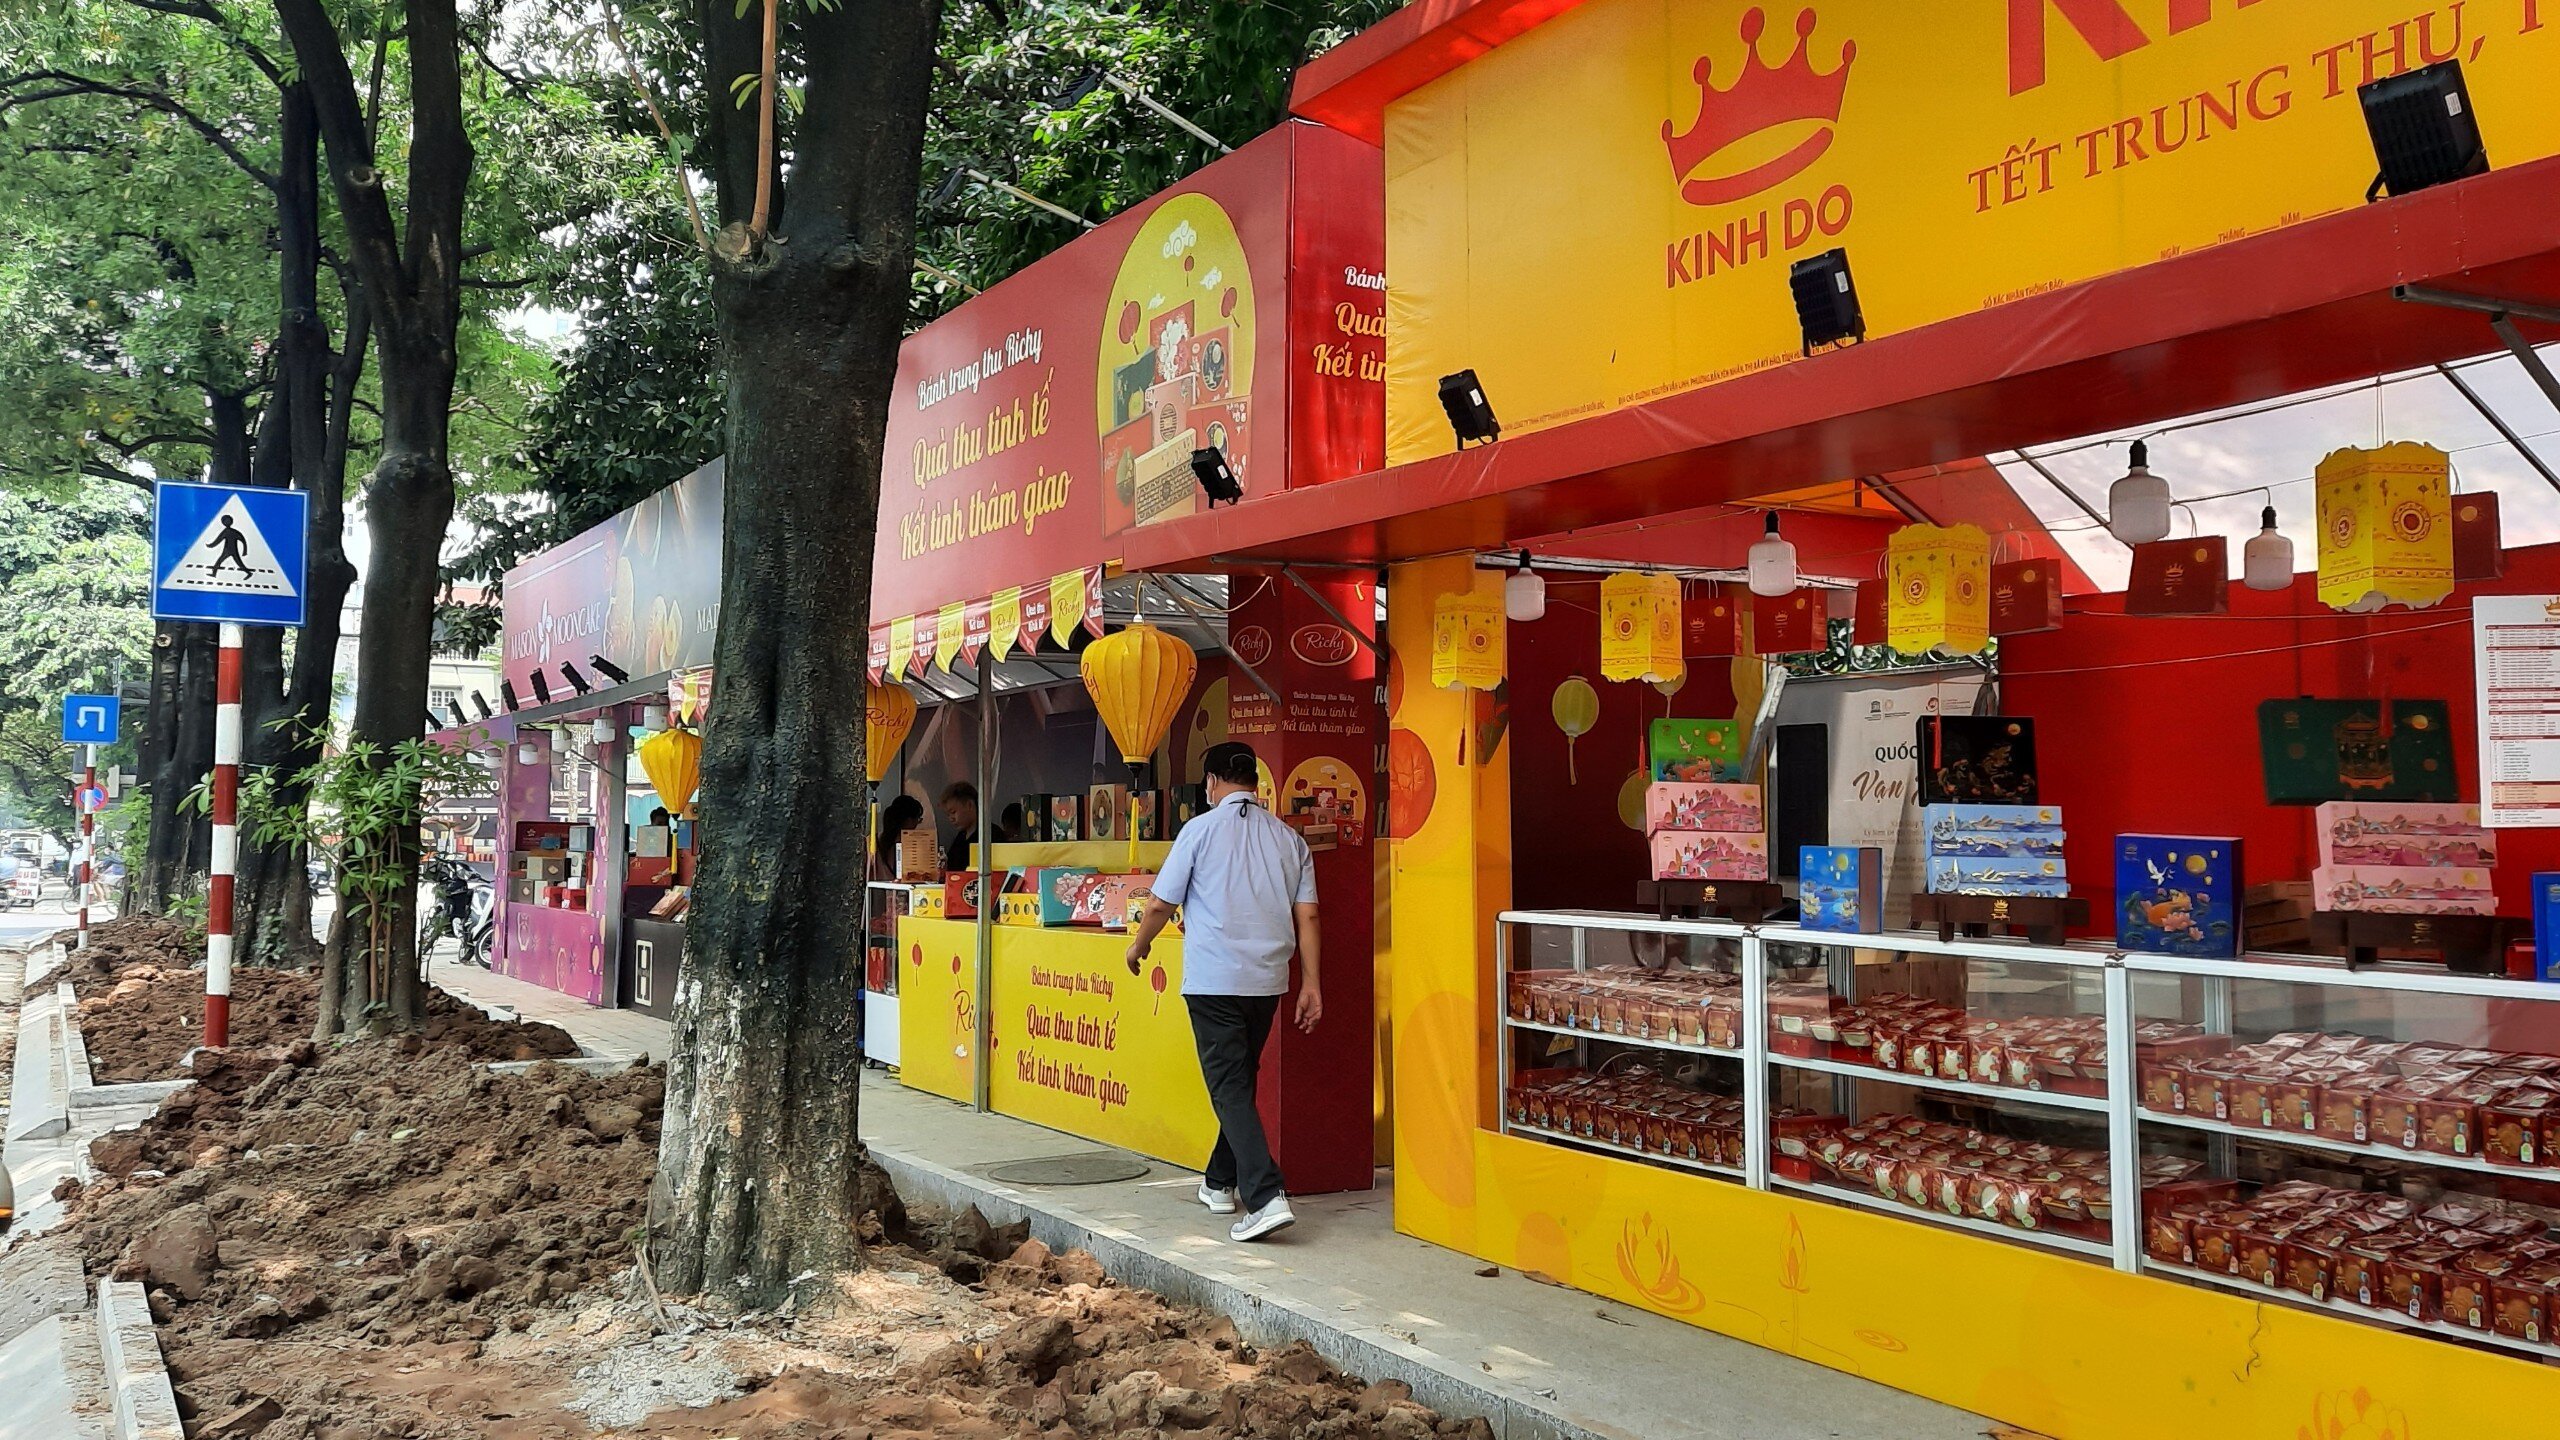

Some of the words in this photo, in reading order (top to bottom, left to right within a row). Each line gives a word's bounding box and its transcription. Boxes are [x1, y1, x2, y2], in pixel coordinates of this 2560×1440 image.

[1968, 137, 2061, 214] TẾT
[2075, 65, 2293, 180] TRUNG
[2311, 1, 2486, 100] THU,
[1667, 210, 1768, 289] KINH
[1784, 184, 1853, 251] DO
[2218, 228, 2245, 244] THÁNG
[2281, 212, 2300, 226] NĂM
[1344, 265, 1386, 291] Bánh
[1335, 302, 1386, 337] Quà
[918, 375, 948, 411] Bánh
[949, 360, 980, 394] trung
[982, 347, 1004, 379] thu
[1006, 327, 1043, 364] Richy
[1313, 341, 1354, 378] Kết
[913, 427, 950, 490] Quà
[952, 421, 985, 470] thu
[986, 397, 1026, 457] tinh
[1030, 367, 1054, 438] tế
[900, 498, 927, 561] Kết
[929, 498, 965, 551] tình
[968, 481, 1020, 538] thâm
[1023, 465, 1073, 536] giao
[552, 601, 601, 647] MOONCAKE
[1239, 628, 1264, 660] Richy
[1304, 628, 1344, 660] Richy
[1312, 705, 1328, 717] thu
[1852, 770, 1904, 803] Vạn
[1031, 965, 1051, 987] Bánh
[1053, 970, 1073, 996] trung
[1075, 972, 1088, 992] thu
[1091, 971, 1114, 1002] Richy
[1027, 1003, 1051, 1039] Quà
[1054, 1011, 1074, 1042] thu
[1077, 1013, 1101, 1049] tinh
[1105, 1011, 1119, 1050] tế
[1017, 1046, 1035, 1083] Kết
[1038, 1054, 1061, 1090] tình
[1064, 1062, 1096, 1098] thâm
[1099, 1071, 1130, 1112] giao
